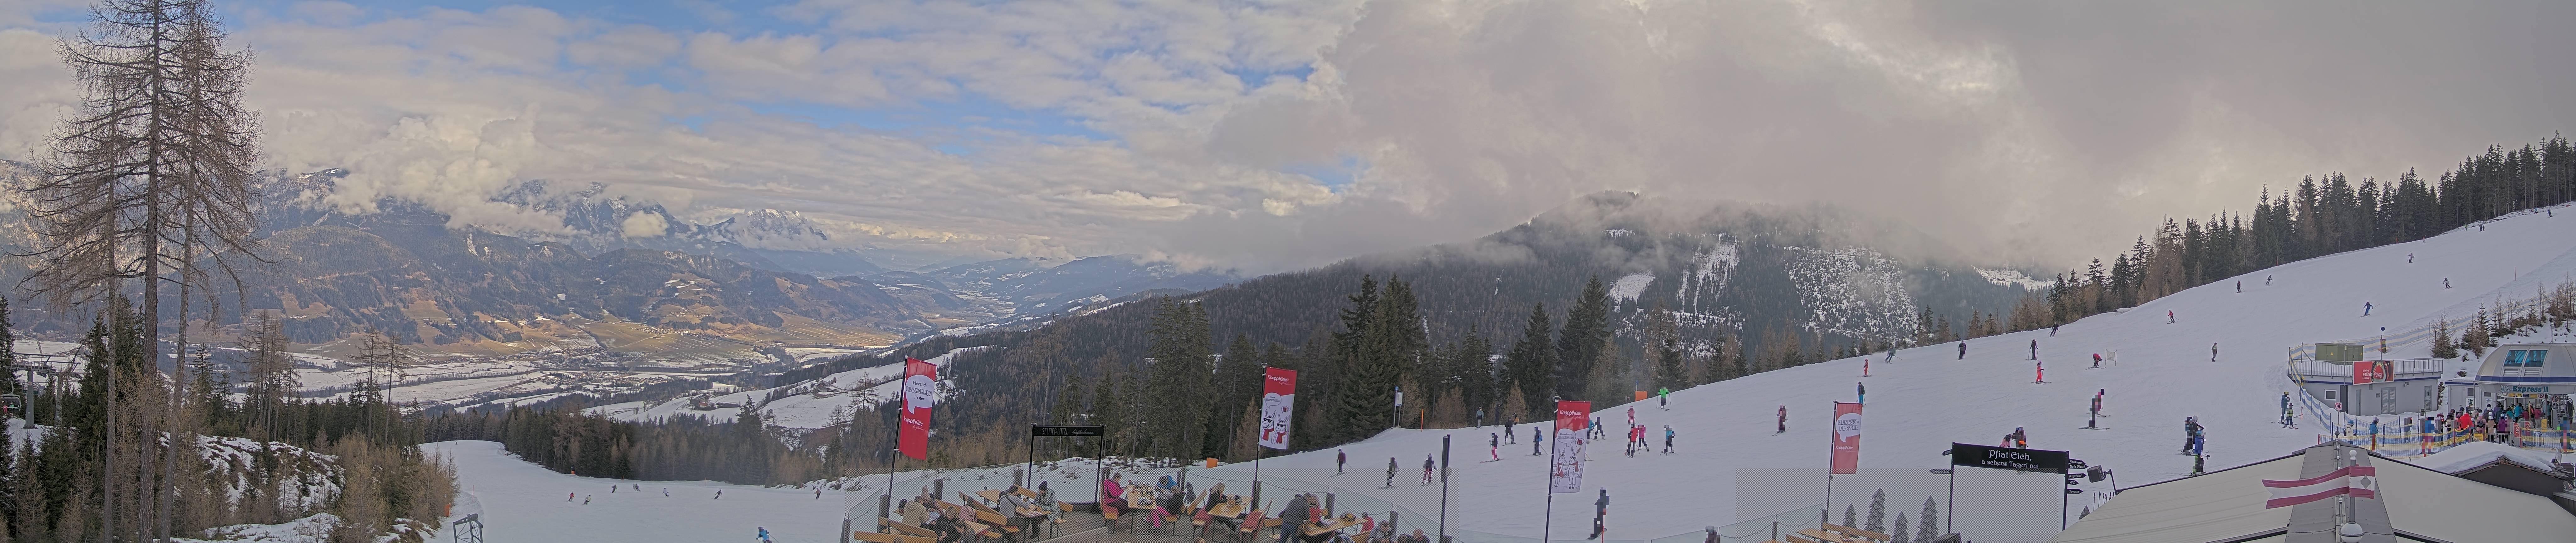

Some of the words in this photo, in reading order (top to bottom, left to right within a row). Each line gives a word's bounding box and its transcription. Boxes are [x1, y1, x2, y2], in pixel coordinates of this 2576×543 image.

[906, 386, 932, 397] WILLKOMMEN
[904, 415, 923, 426] Knapplhütte
[1989, 450, 2008, 459] Pfiat
[2011, 452, 2032, 461] Eich,
